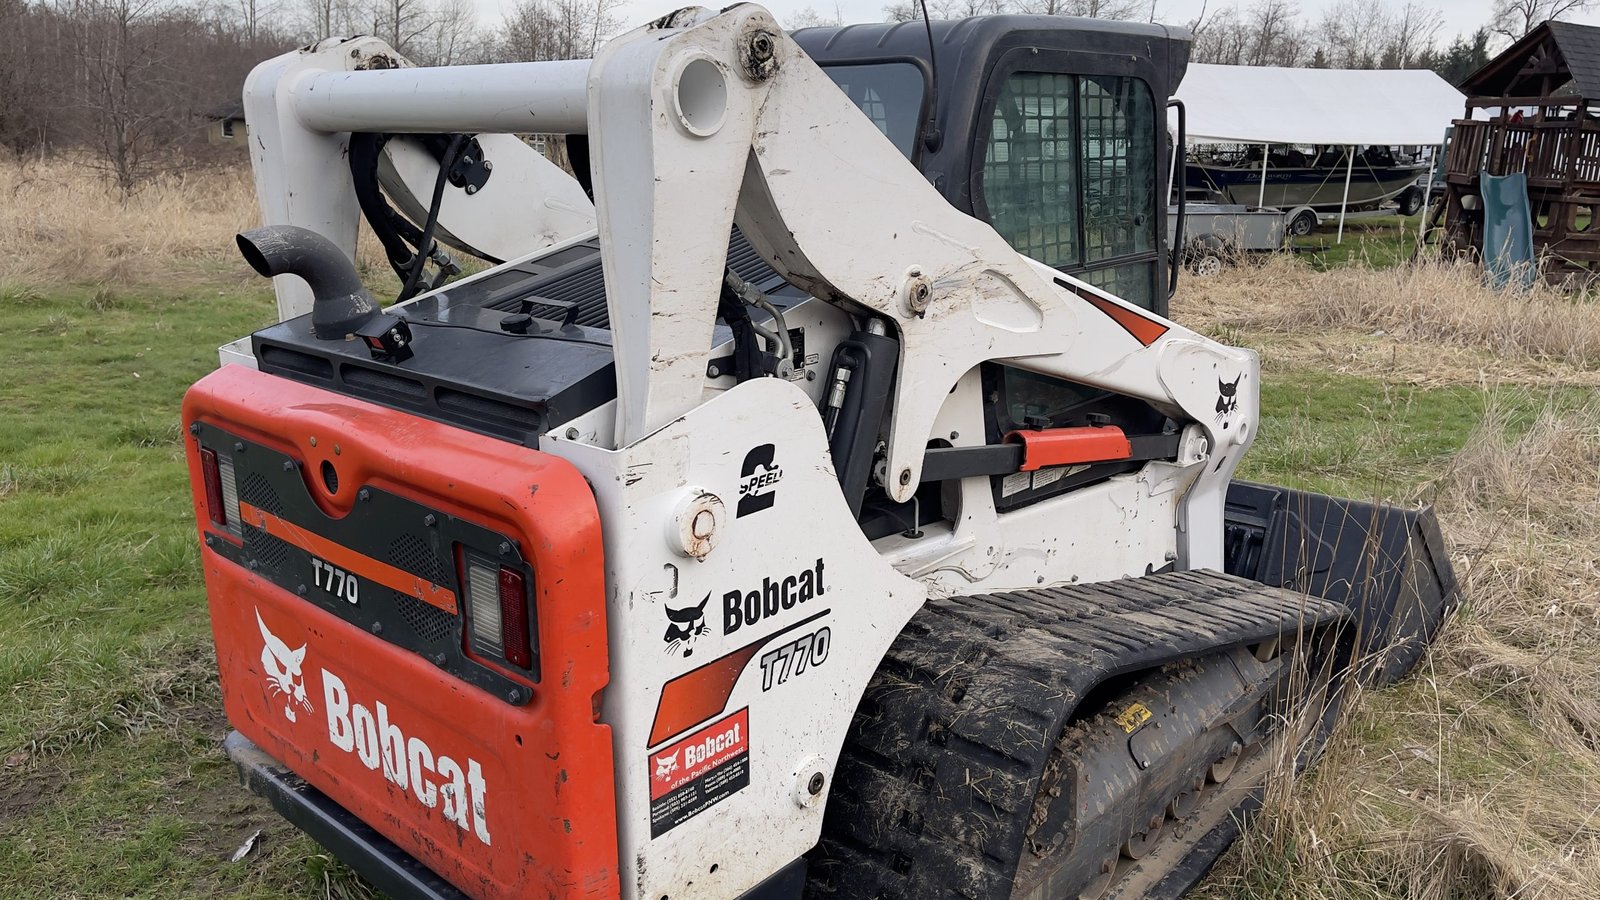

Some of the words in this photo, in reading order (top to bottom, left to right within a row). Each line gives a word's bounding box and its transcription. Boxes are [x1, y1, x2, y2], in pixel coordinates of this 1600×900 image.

[739, 469, 783, 494] SPEED
[311, 557, 359, 604] T770
[722, 557, 825, 636] Bobcat
[760, 626, 831, 692] T770
[320, 667, 491, 846] Bobcat
[670, 780, 678, 790] of
[679, 776, 690, 786] the
[691, 764, 711, 780] Pacific
[712, 746, 744, 767] Northwest
[685, 722, 740, 770] Bobcat
